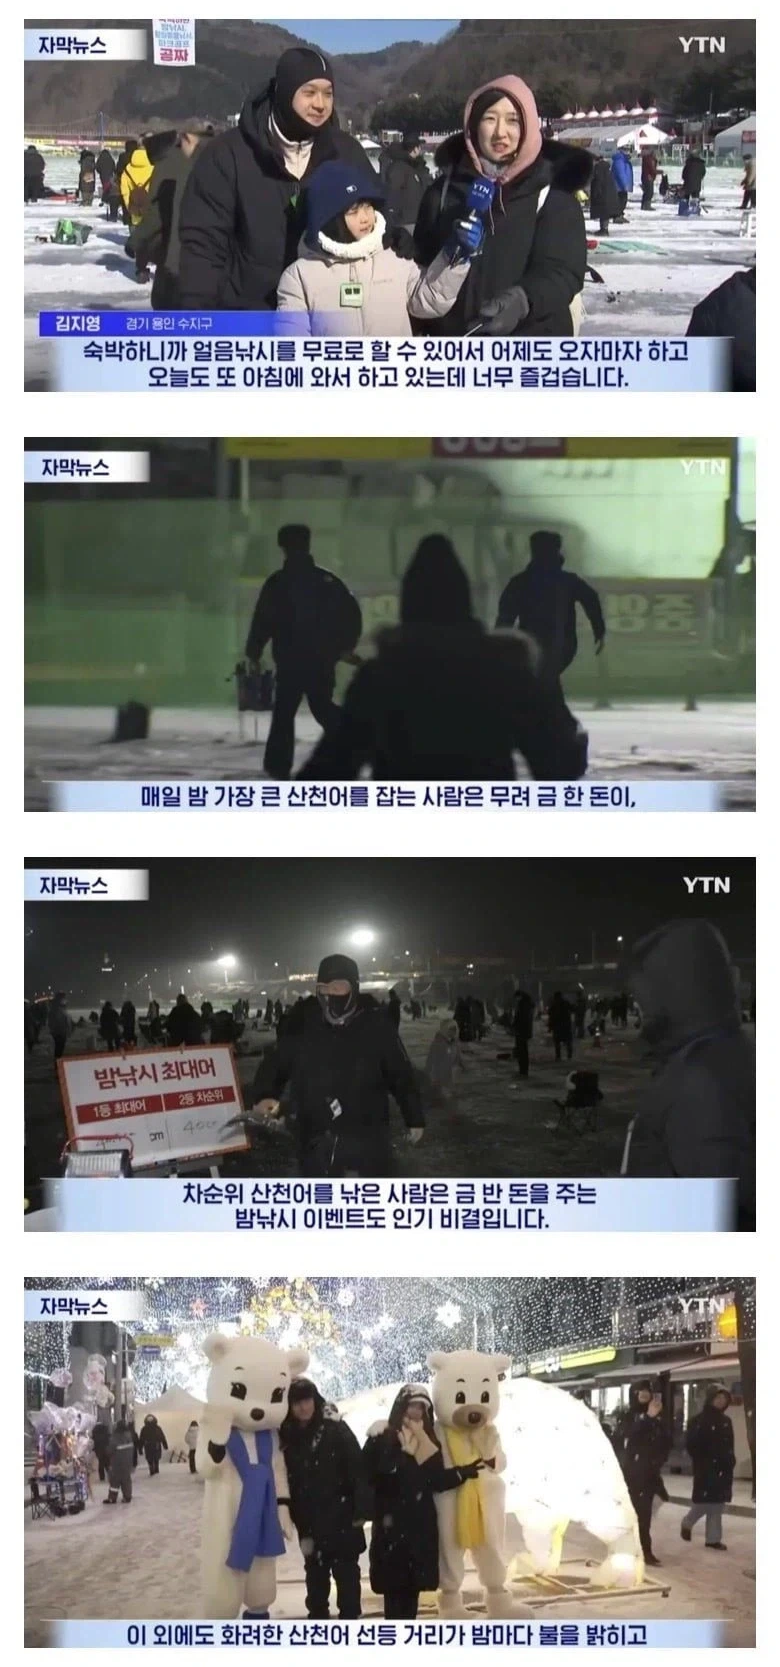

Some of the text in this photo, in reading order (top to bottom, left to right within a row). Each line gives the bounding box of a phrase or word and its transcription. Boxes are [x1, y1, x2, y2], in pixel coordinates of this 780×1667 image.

[160, 47, 189, 63] 공짜
[473, 182, 490, 194] YTN
[94, 1057, 217, 1090] 밤낚시 최대어
[178, 1089, 224, 1107] 2등 차순위
[93, 1098, 147, 1119] 1등 최대어
